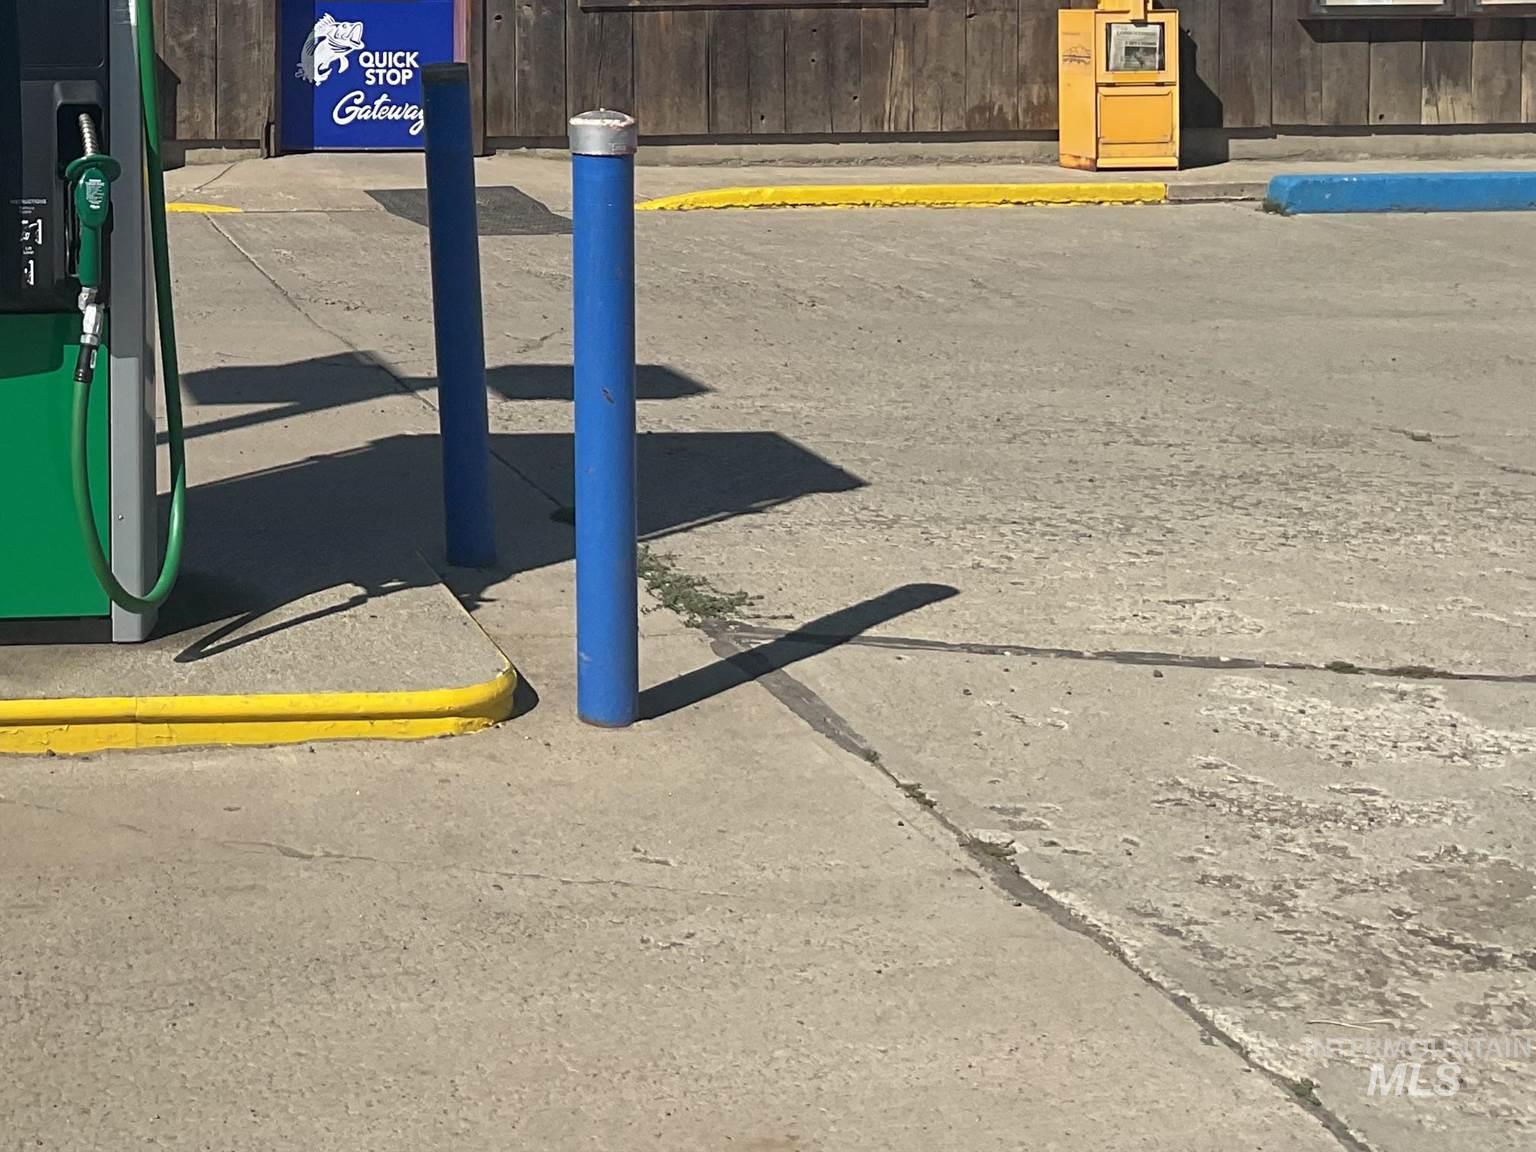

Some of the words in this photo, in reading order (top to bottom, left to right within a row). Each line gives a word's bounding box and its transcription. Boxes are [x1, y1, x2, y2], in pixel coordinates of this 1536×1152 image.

[359, 52, 420, 70] QUICK
[365, 68, 414, 86] STOP
[332, 90, 424, 136] Gateway
